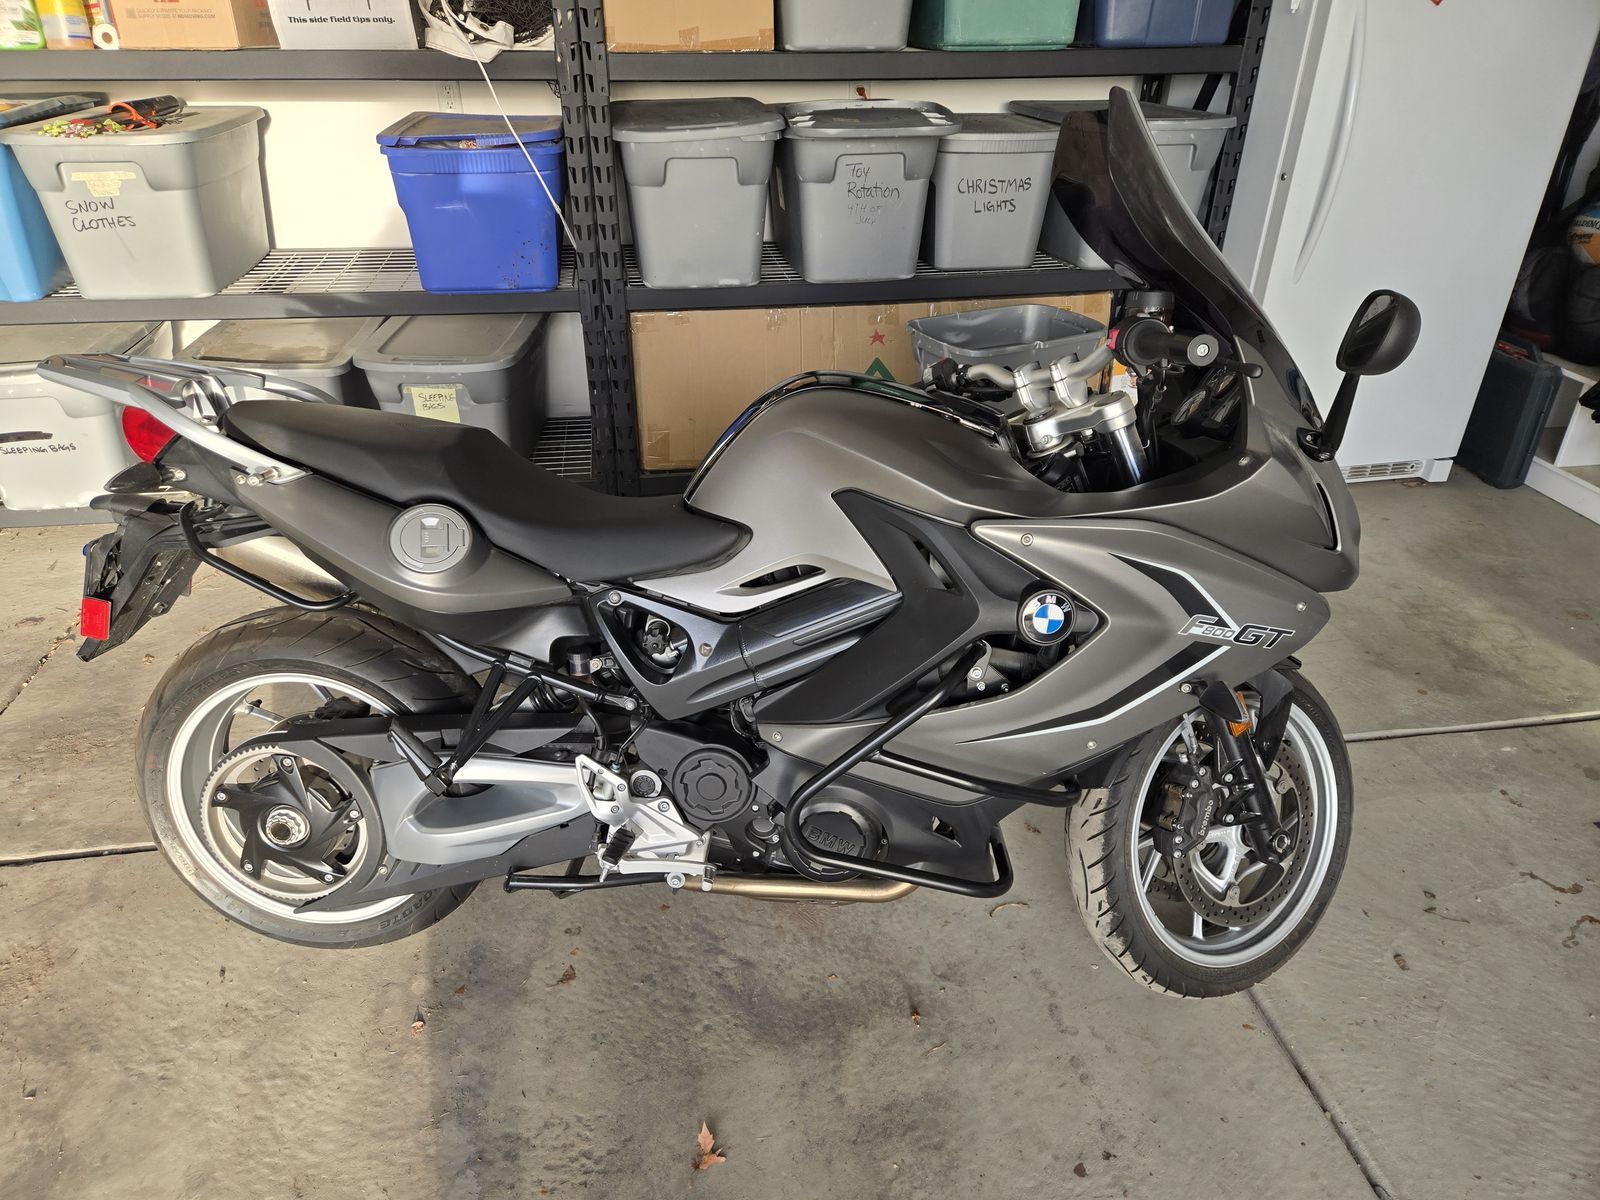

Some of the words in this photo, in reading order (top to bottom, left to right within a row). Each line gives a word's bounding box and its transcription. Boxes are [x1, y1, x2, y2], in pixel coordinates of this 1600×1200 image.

[287, 15, 307, 23] This
[309, 15, 328, 23] side
[330, 15, 351, 23] field
[352, 15, 371, 24] tips
[372, 15, 396, 25] only.
[845, 162, 870, 182] Toy
[847, 181, 900, 199] Rotation
[957, 176, 1032, 195] CHRISTMAS
[65, 196, 115, 215] SNOW
[974, 198, 1017, 213] LIGHTS
[72, 215, 137, 233] CLOTHES
[0, 446, 49, 455] SLEEPING
[49, 443, 77, 453] BAGS
[1198, 800, 1214, 836] brembo
[806, 825, 856, 856] BMW
